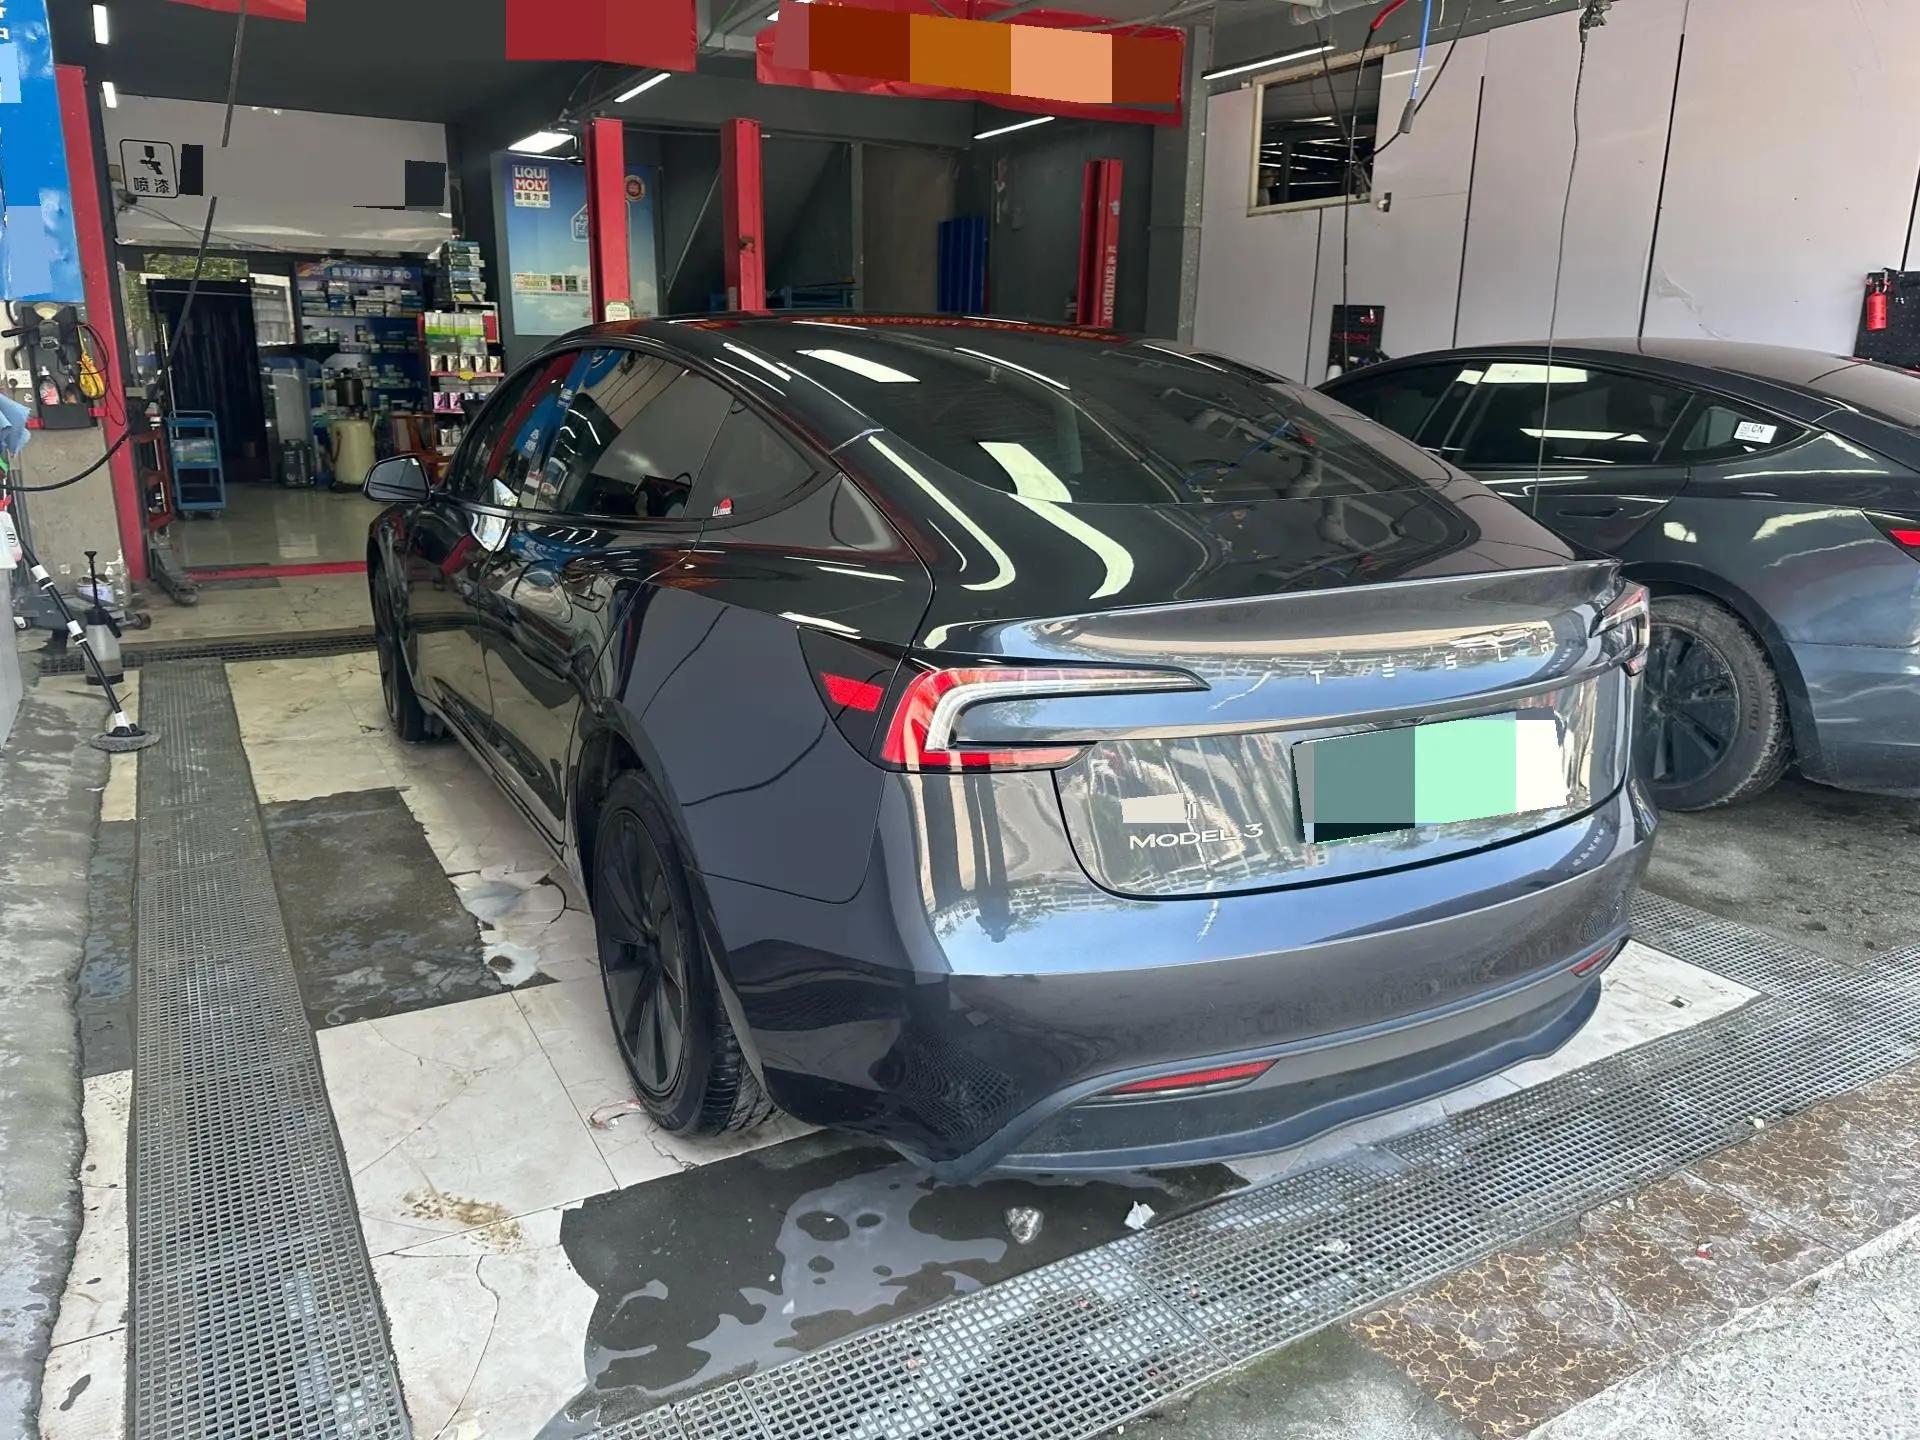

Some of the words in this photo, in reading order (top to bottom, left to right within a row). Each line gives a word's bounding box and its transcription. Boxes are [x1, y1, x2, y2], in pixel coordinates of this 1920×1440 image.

[514, 167, 547, 179] LIQUI
[133, 177, 170, 193] 喷漆
[515, 179, 547, 191] MOLY
[1129, 828, 1236, 850] MODEL
[1243, 822, 1264, 838] 3
